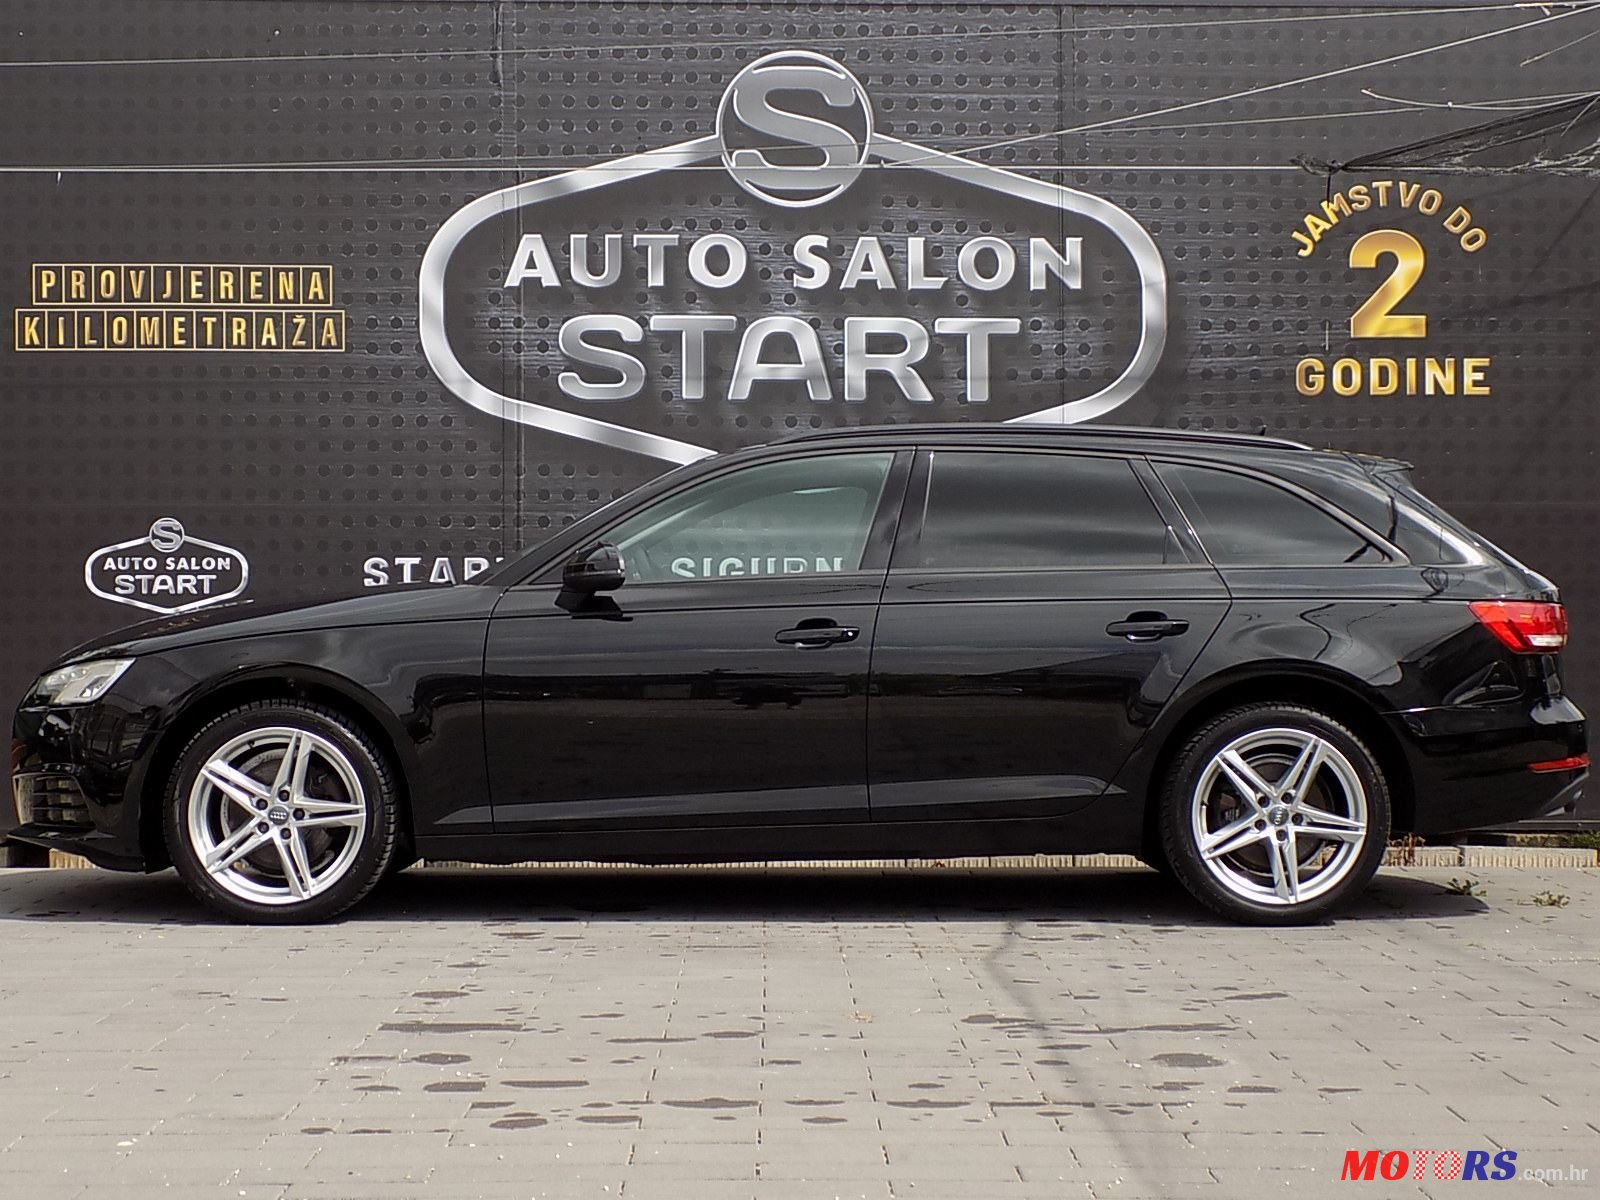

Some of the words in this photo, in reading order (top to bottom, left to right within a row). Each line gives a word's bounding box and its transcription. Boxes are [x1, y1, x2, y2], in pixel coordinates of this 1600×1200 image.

[726, 62, 864, 192] S
[1291, 180, 1443, 257] JAMSTVO
[1443, 206, 1487, 252] DO
[504, 233, 747, 288] AUTO
[793, 236, 1083, 291] SALON
[40, 269, 325, 300] PROVJERENA
[1349, 229, 1426, 338] 2
[24, 314, 339, 346] KILOMETRAŽA
[557, 314, 1021, 402] START
[1295, 357, 1491, 396] GODINE
[103, 557, 157, 570] AUTO
[165, 557, 231, 570] SALON
[363, 557, 505, 587] STAR
[114, 574, 217, 595] START
